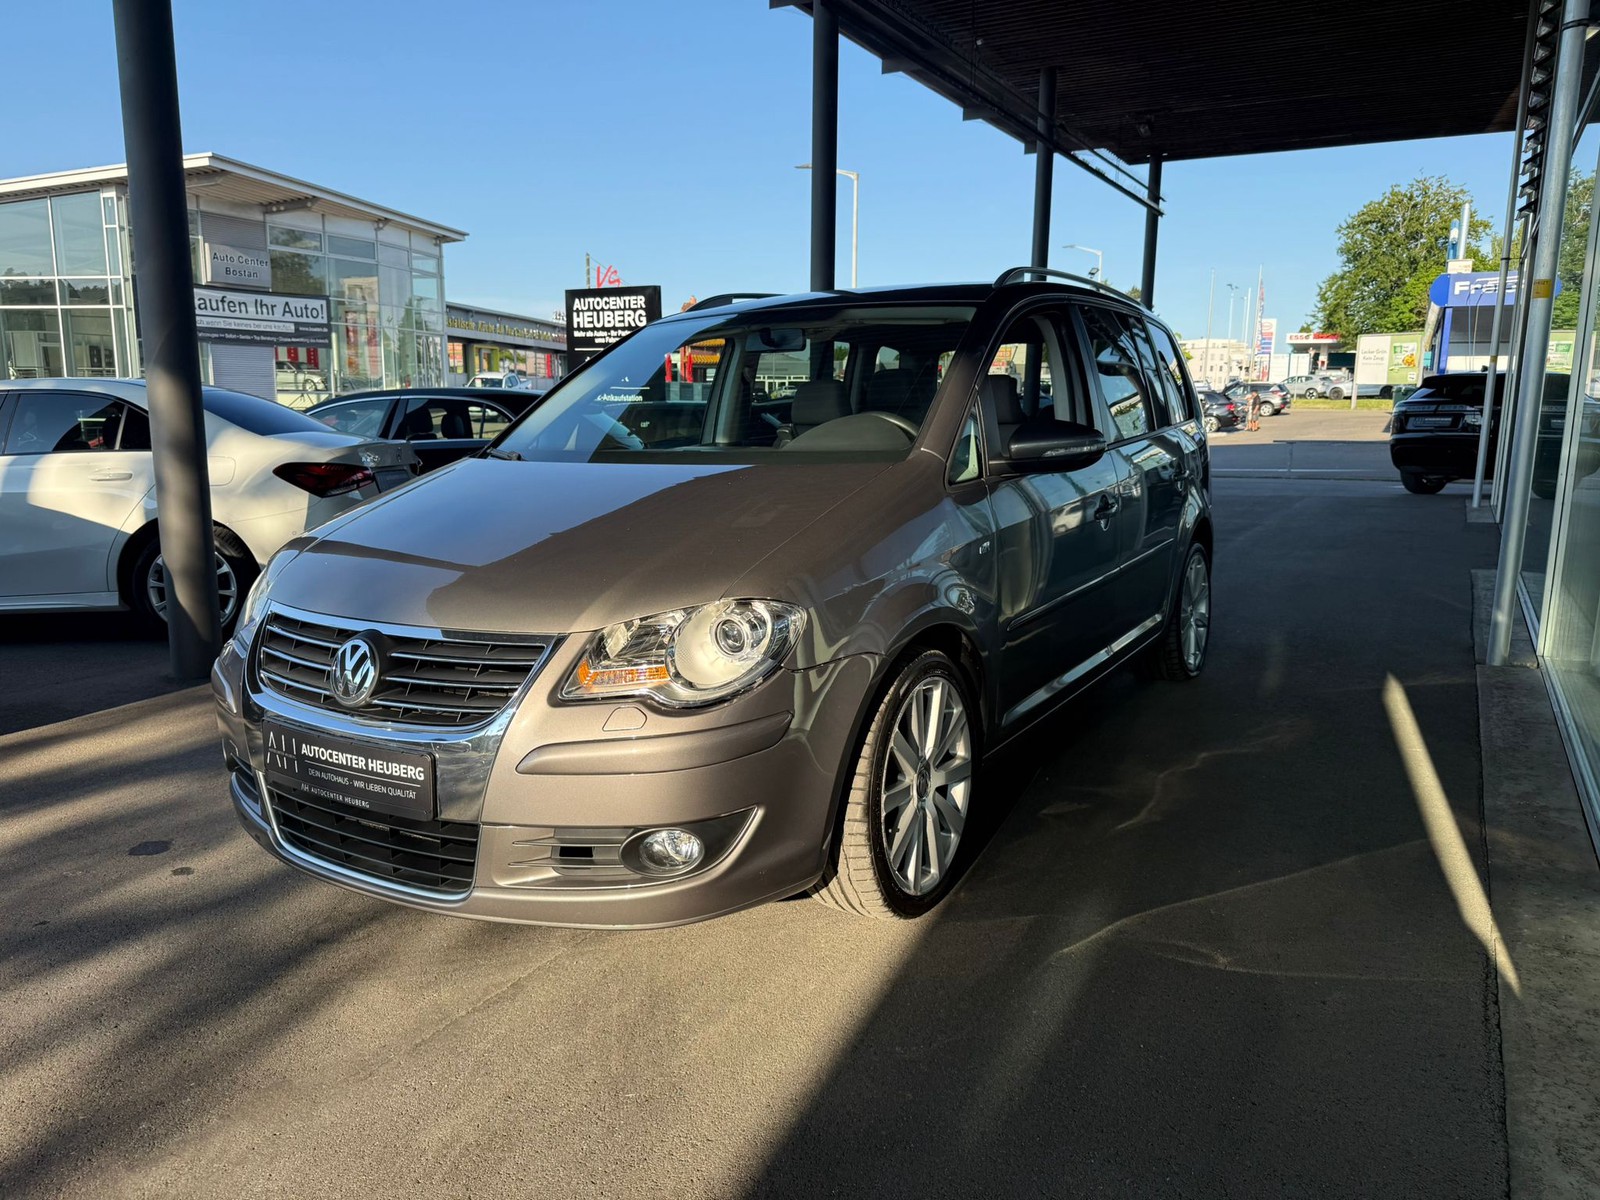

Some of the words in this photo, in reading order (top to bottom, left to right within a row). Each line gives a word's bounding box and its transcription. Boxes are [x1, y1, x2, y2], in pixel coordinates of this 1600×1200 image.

[212, 252, 235, 263] Auto
[239, 256, 269, 267] Center
[225, 267, 258, 278] Bostan
[195, 296, 249, 314] aufen
[254, 298, 277, 316] Ihr
[281, 301, 324, 319] Auto!
[573, 295, 646, 310] AUTOCENTER
[573, 310, 647, 328] HEUBERG
[301, 743, 366, 770] AUTOCENTER
[367, 758, 425, 781] HEUBERG
[308, 767, 320, 778] DEIN
[321, 772, 349, 785] AUTOHAUS
[353, 779, 365, 789] WIR
[365, 783, 387, 794] LIEBEN
[387, 786, 417, 799] QUALITÄT
[311, 787, 345, 801] AUTOCENTER
[345, 796, 370, 808] HEUBERG
